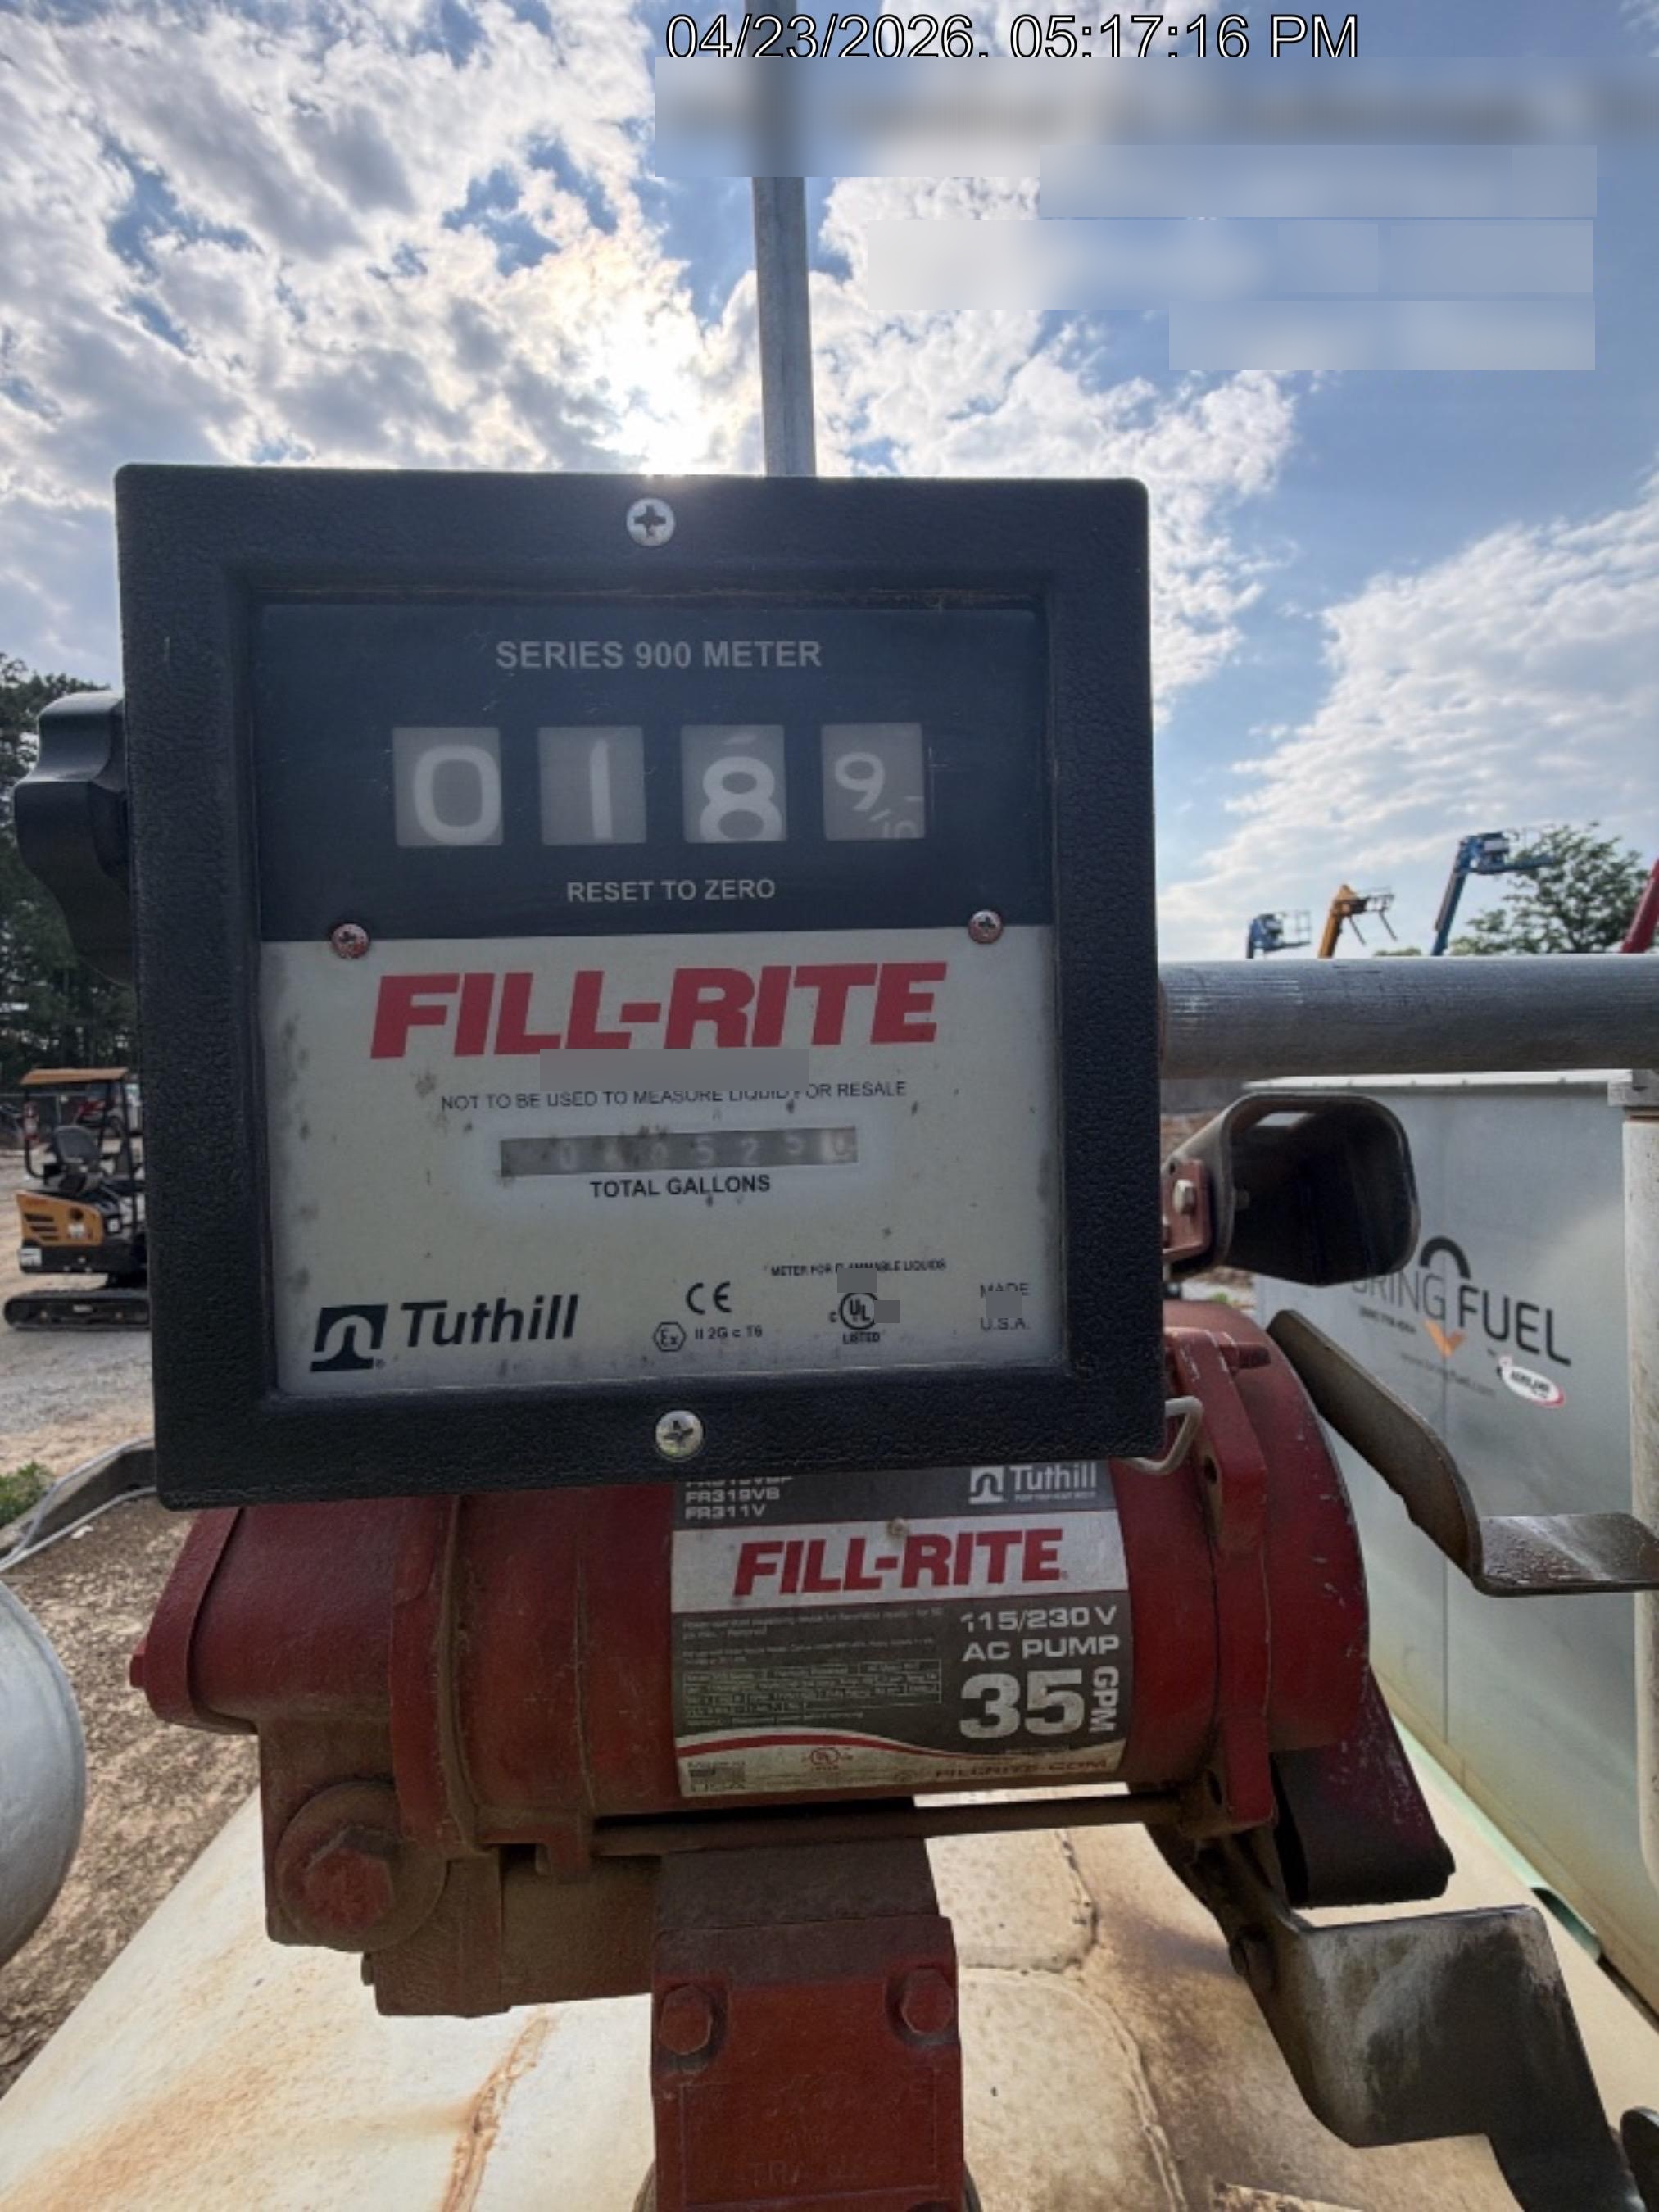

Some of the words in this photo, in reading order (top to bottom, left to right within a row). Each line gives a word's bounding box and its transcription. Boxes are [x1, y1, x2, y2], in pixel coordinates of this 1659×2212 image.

[496, 641, 623, 669] SERIES
[635, 641, 691, 668] 900
[704, 641, 821, 667] METER
[567, 882, 654, 903] RESET
[660, 880, 696, 902] TO
[705, 878, 775, 900] ZERO
[370, 962, 947, 1059] FILL-RITE
[441, 1095, 479, 1111] NOT
[486, 1093, 511, 1109] TO
[516, 1093, 541, 1108] BE
[547, 1091, 597, 1107] USED
[603, 1090, 628, 1105] TO
[633, 1090, 723, 1104] MEASURE
[837, 1081, 907, 1098] RESALE
[590, 1178, 660, 1199] TOTAL
[666, 1175, 770, 1196] GALLONS
[771, 1265, 807, 1276] METER
[686, 1281, 732, 1315] CE
[400, 1294, 579, 1348] Tuthill
[1458, 1284, 1571, 1367] FUEL
[842, 1331, 881, 1344] LISTED
[1009, 1462, 1097, 1492] Tuthill
[733, 1529, 1063, 1597] FILL-RITE
[960, 1607, 1090, 1634] 115/230
[1095, 1606, 1117, 1625] V
[963, 1640, 1010, 1662] AC
[1022, 1635, 1119, 1658] PUMP
[959, 1668, 1085, 1739] 35
[1088, 1666, 1119, 1734] GPM
